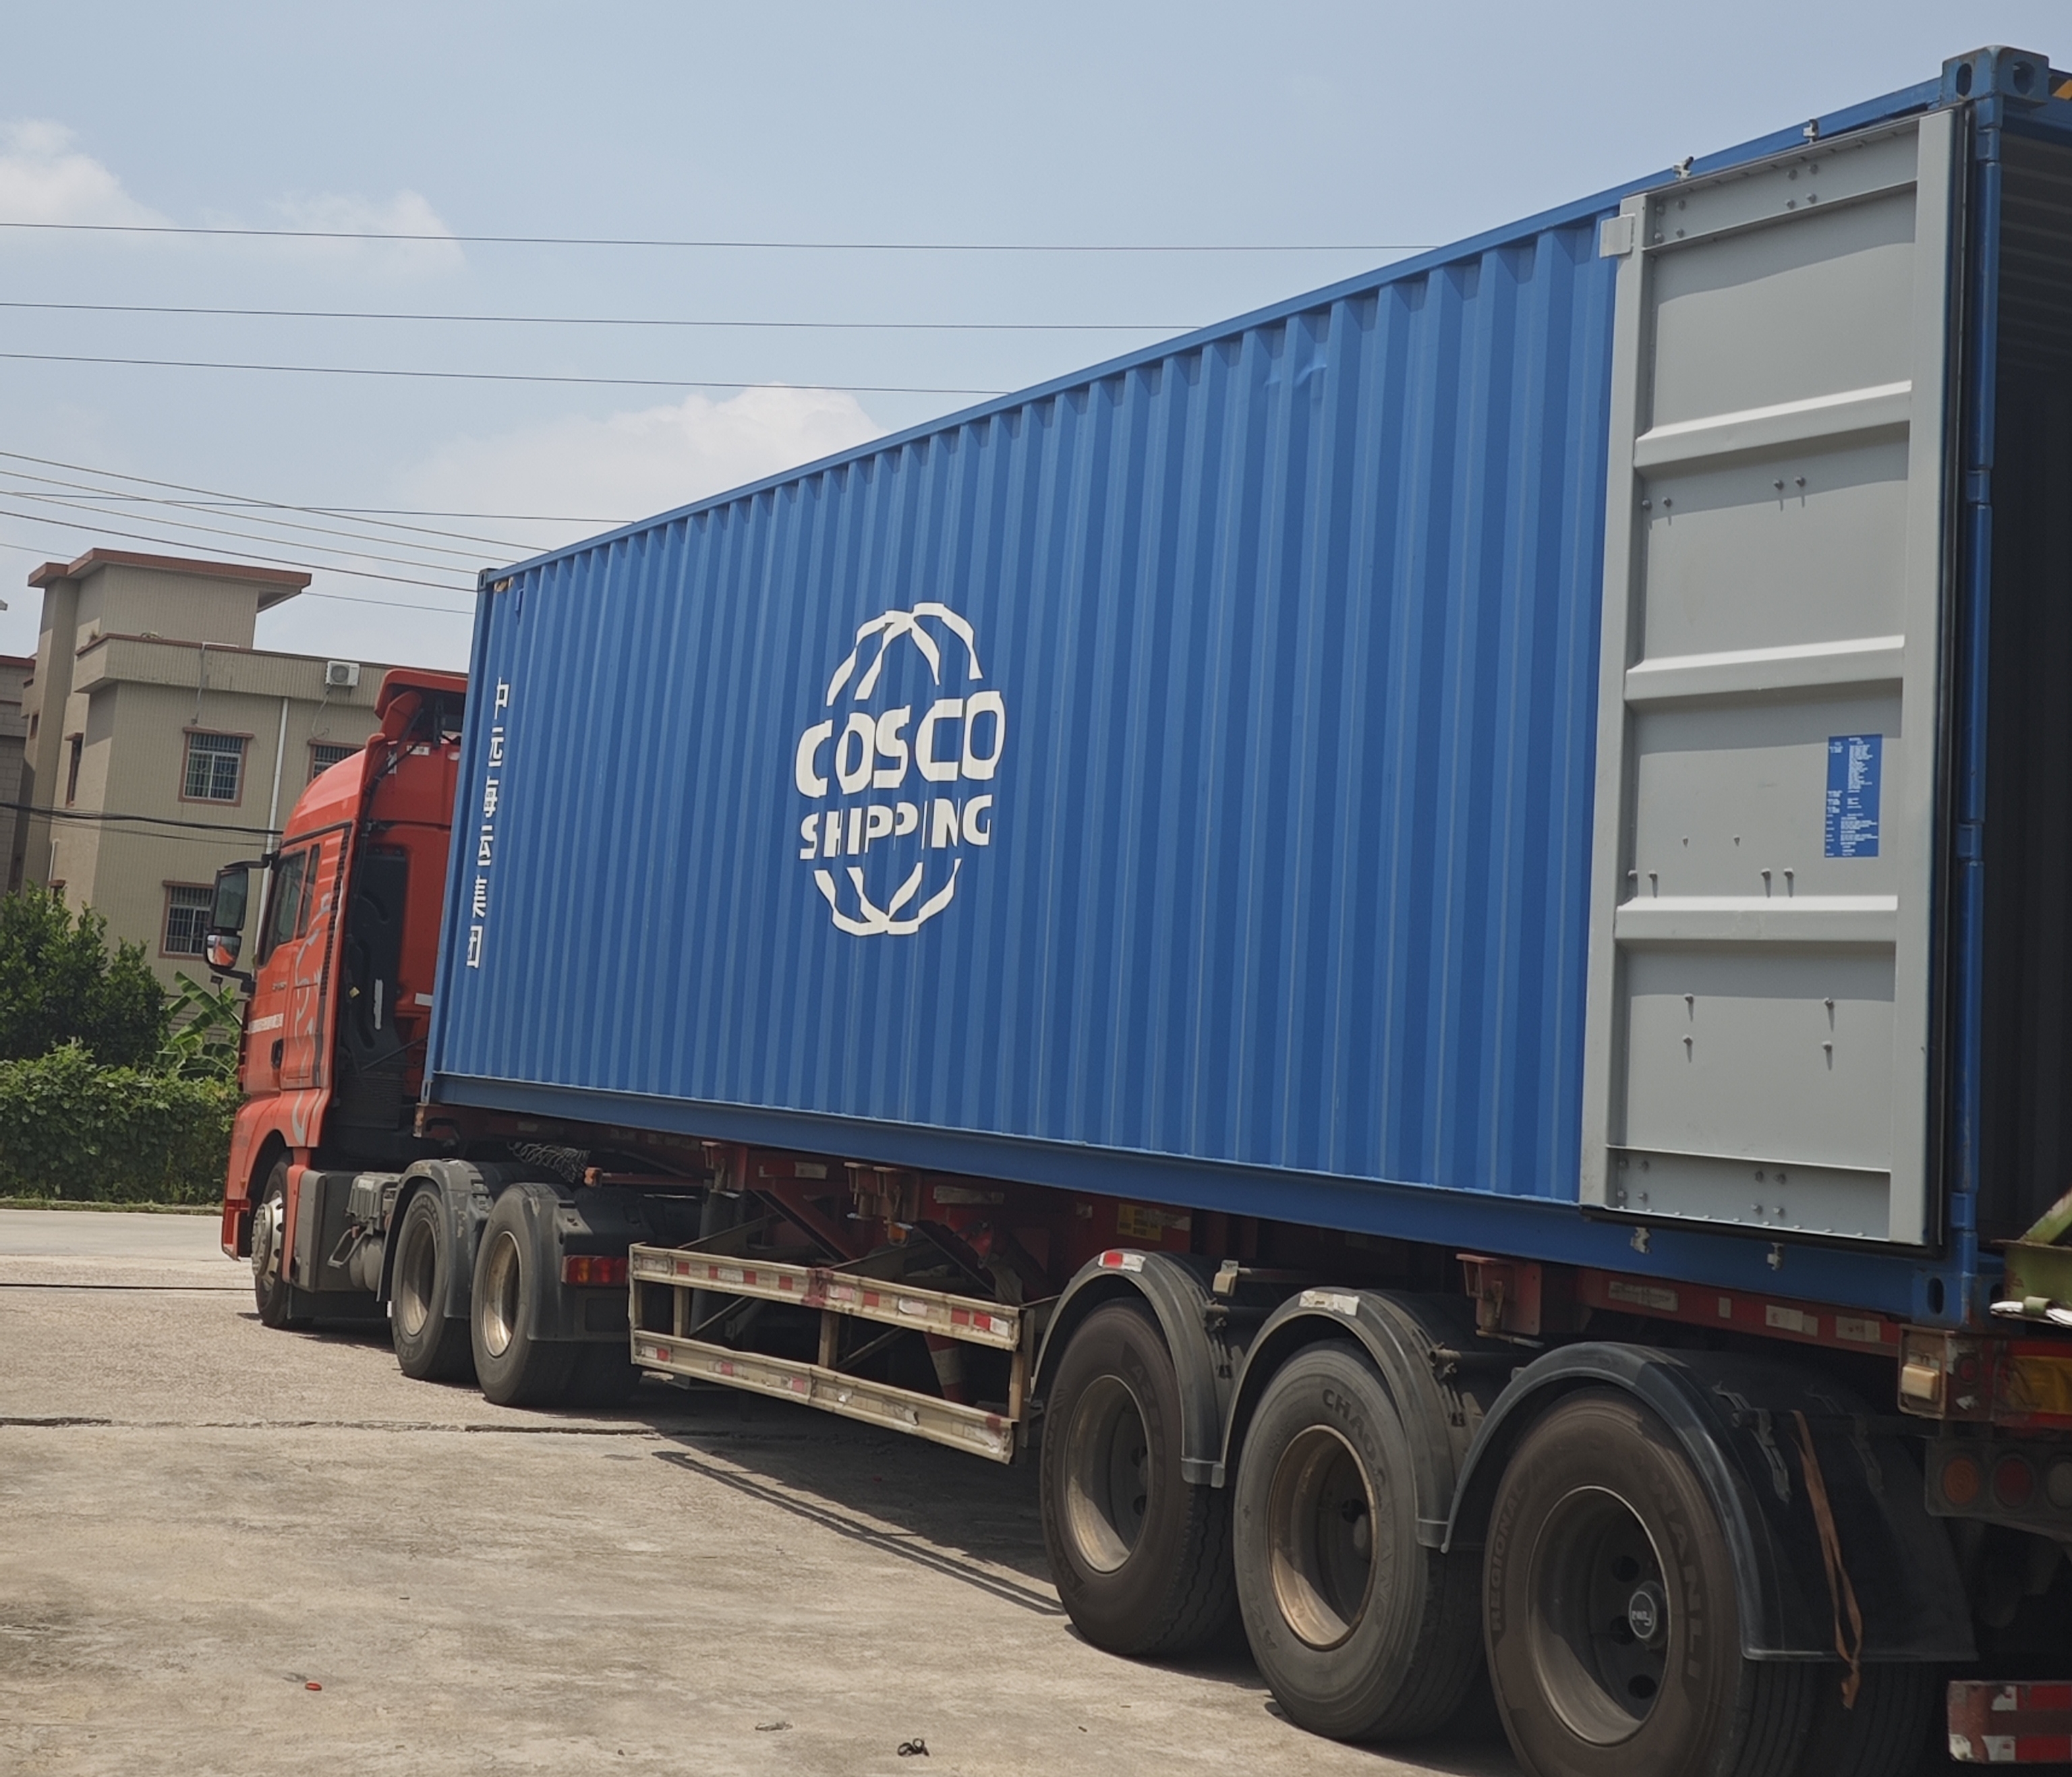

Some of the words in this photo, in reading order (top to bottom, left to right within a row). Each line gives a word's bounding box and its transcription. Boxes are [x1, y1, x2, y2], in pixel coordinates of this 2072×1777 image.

[795, 690, 1006, 798] COSCO
[800, 794, 993, 860] SHIPPING
[1490, 1485, 1527, 1633] REGIONAL
